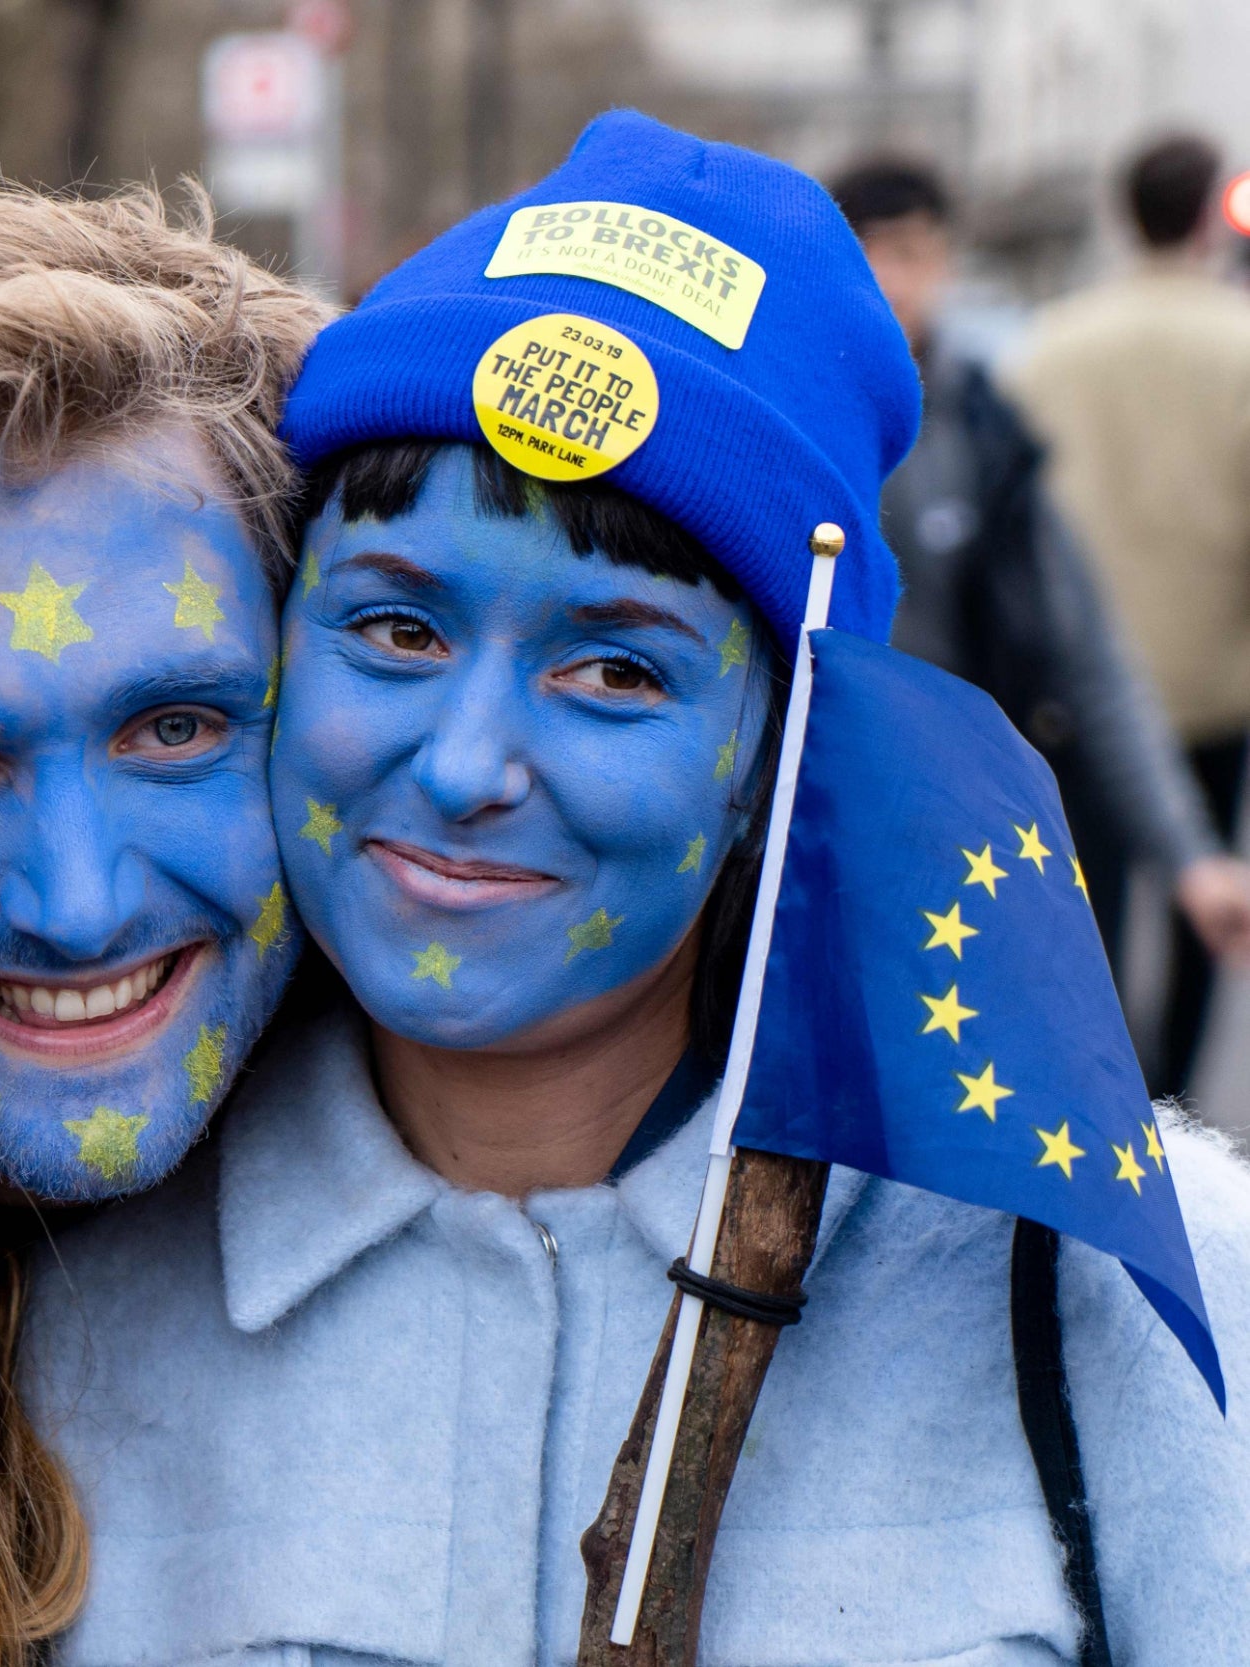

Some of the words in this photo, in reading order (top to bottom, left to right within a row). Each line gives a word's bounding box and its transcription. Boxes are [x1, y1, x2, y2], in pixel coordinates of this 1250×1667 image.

[523, 225, 574, 246] TO
[591, 227, 737, 301] BREXIT
[531, 208, 741, 279] BOLLOCKS
[516, 245, 551, 261] IT'S
[558, 245, 598, 260] NOT
[604, 252, 615, 264] A
[625, 257, 676, 289] DONE
[681, 284, 723, 319] DEAL
[522, 341, 572, 372] PUT
[573, 360, 601, 383] IT
[605, 372, 634, 400] TO
[561, 326, 623, 359] 23.03.19
[491, 354, 542, 388] THE
[544, 373, 646, 432] PEOPLE
[497, 384, 611, 450] MARCH
[527, 435, 557, 456] PARK
[557, 448, 587, 469] LANE
